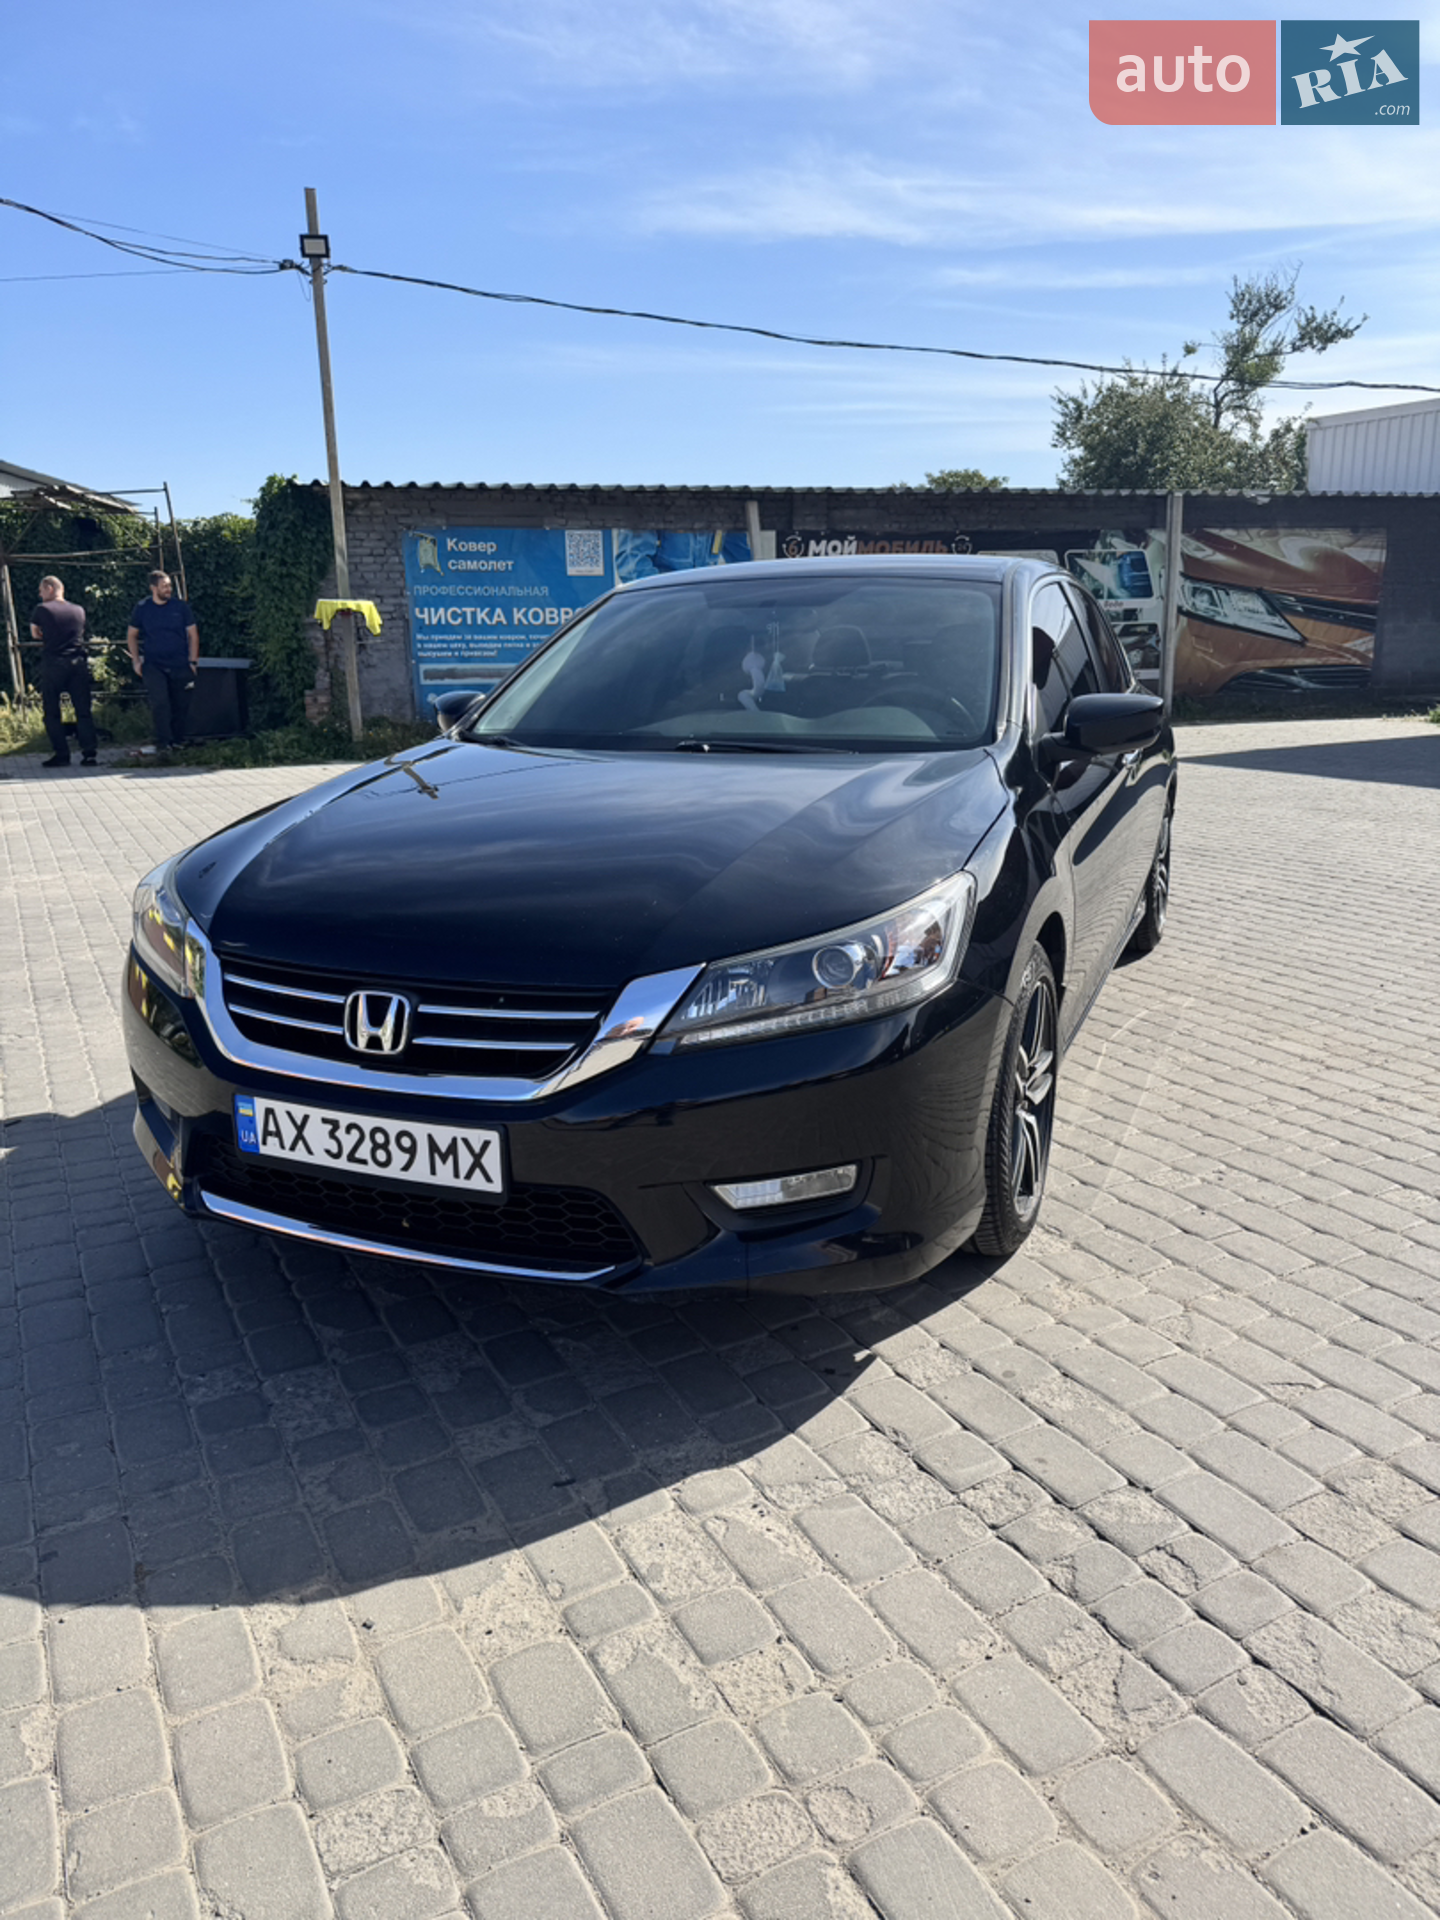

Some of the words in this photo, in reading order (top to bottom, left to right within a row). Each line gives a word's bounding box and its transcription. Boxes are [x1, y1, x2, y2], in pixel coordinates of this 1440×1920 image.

[446, 537, 498, 553] Ковер
[447, 558, 515, 573] самолет
[413, 584, 549, 597] ПРОФЕССИОНАЛЬНАЯ
[415, 607, 507, 625] ЧИСТКА
[241, 1130, 257, 1144] UA
[261, 1107, 314, 1156] AX
[321, 1117, 418, 1172] 3289
[427, 1133, 494, 1184] MX
